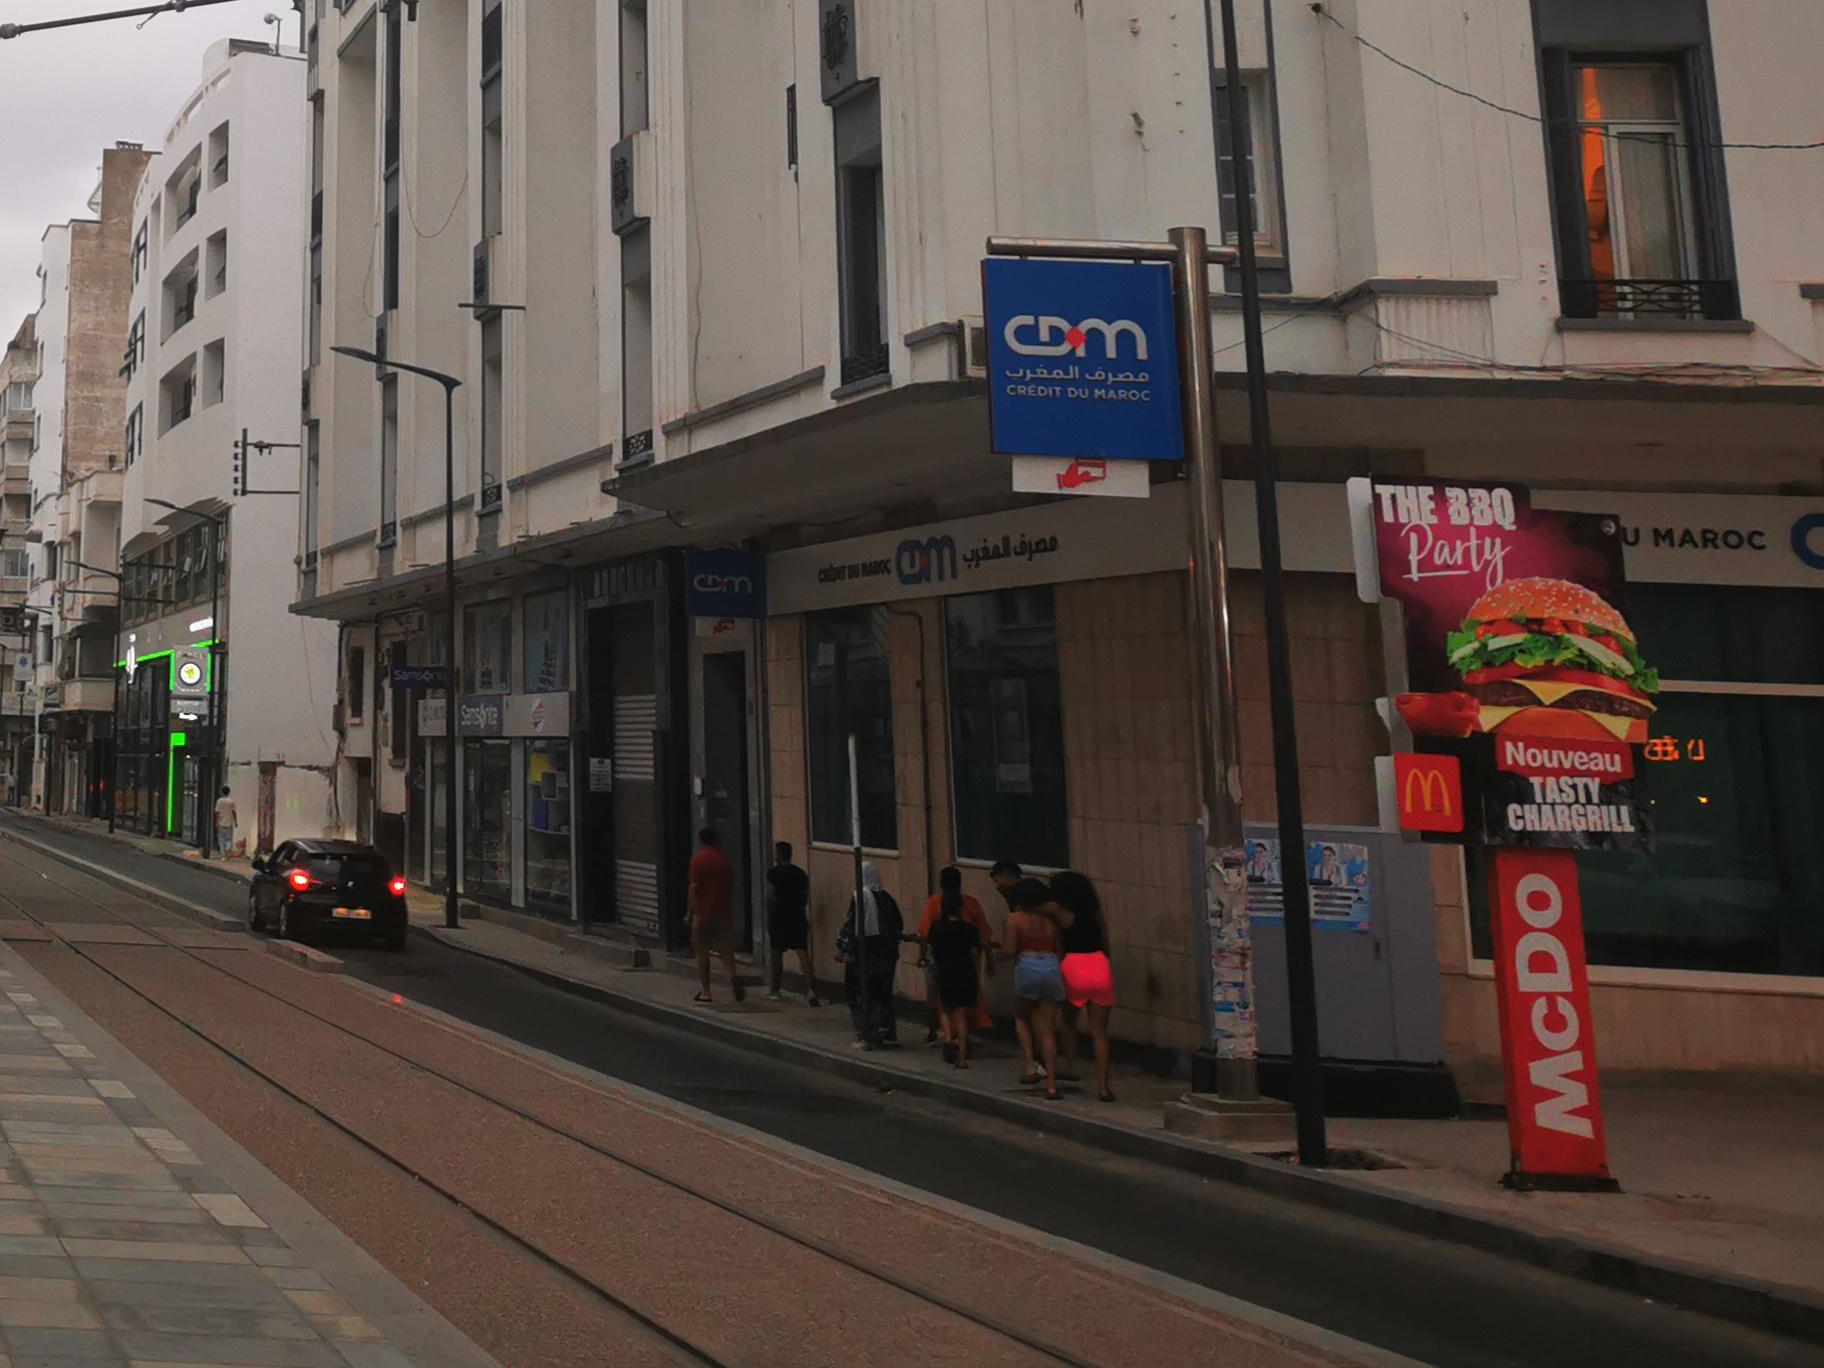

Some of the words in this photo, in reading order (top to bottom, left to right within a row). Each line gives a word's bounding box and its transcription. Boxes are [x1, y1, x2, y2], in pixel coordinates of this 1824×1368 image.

[1005, 364, 1080, 382] المغرب
[1084, 367, 1150, 385] مصرف
[1006, 382, 1062, 398] CRÉDIT
[1067, 386, 1089, 399] DU
[1094, 387, 1151, 402] MAROC
[1375, 483, 1438, 525] THE
[1444, 485, 1516, 531] BBQ
[1013, 534, 1059, 562] مصرف
[1653, 526, 1768, 551] MAROC
[962, 536, 1011, 570] المغرب
[1399, 521, 1512, 591] Party
[847, 562, 860, 580] DU
[861, 557, 892, 577] MAROC
[1503, 741, 1622, 773] Nouveau
[1528, 775, 1601, 804] TASTY
[1506, 803, 1635, 833] CHARGRILL
